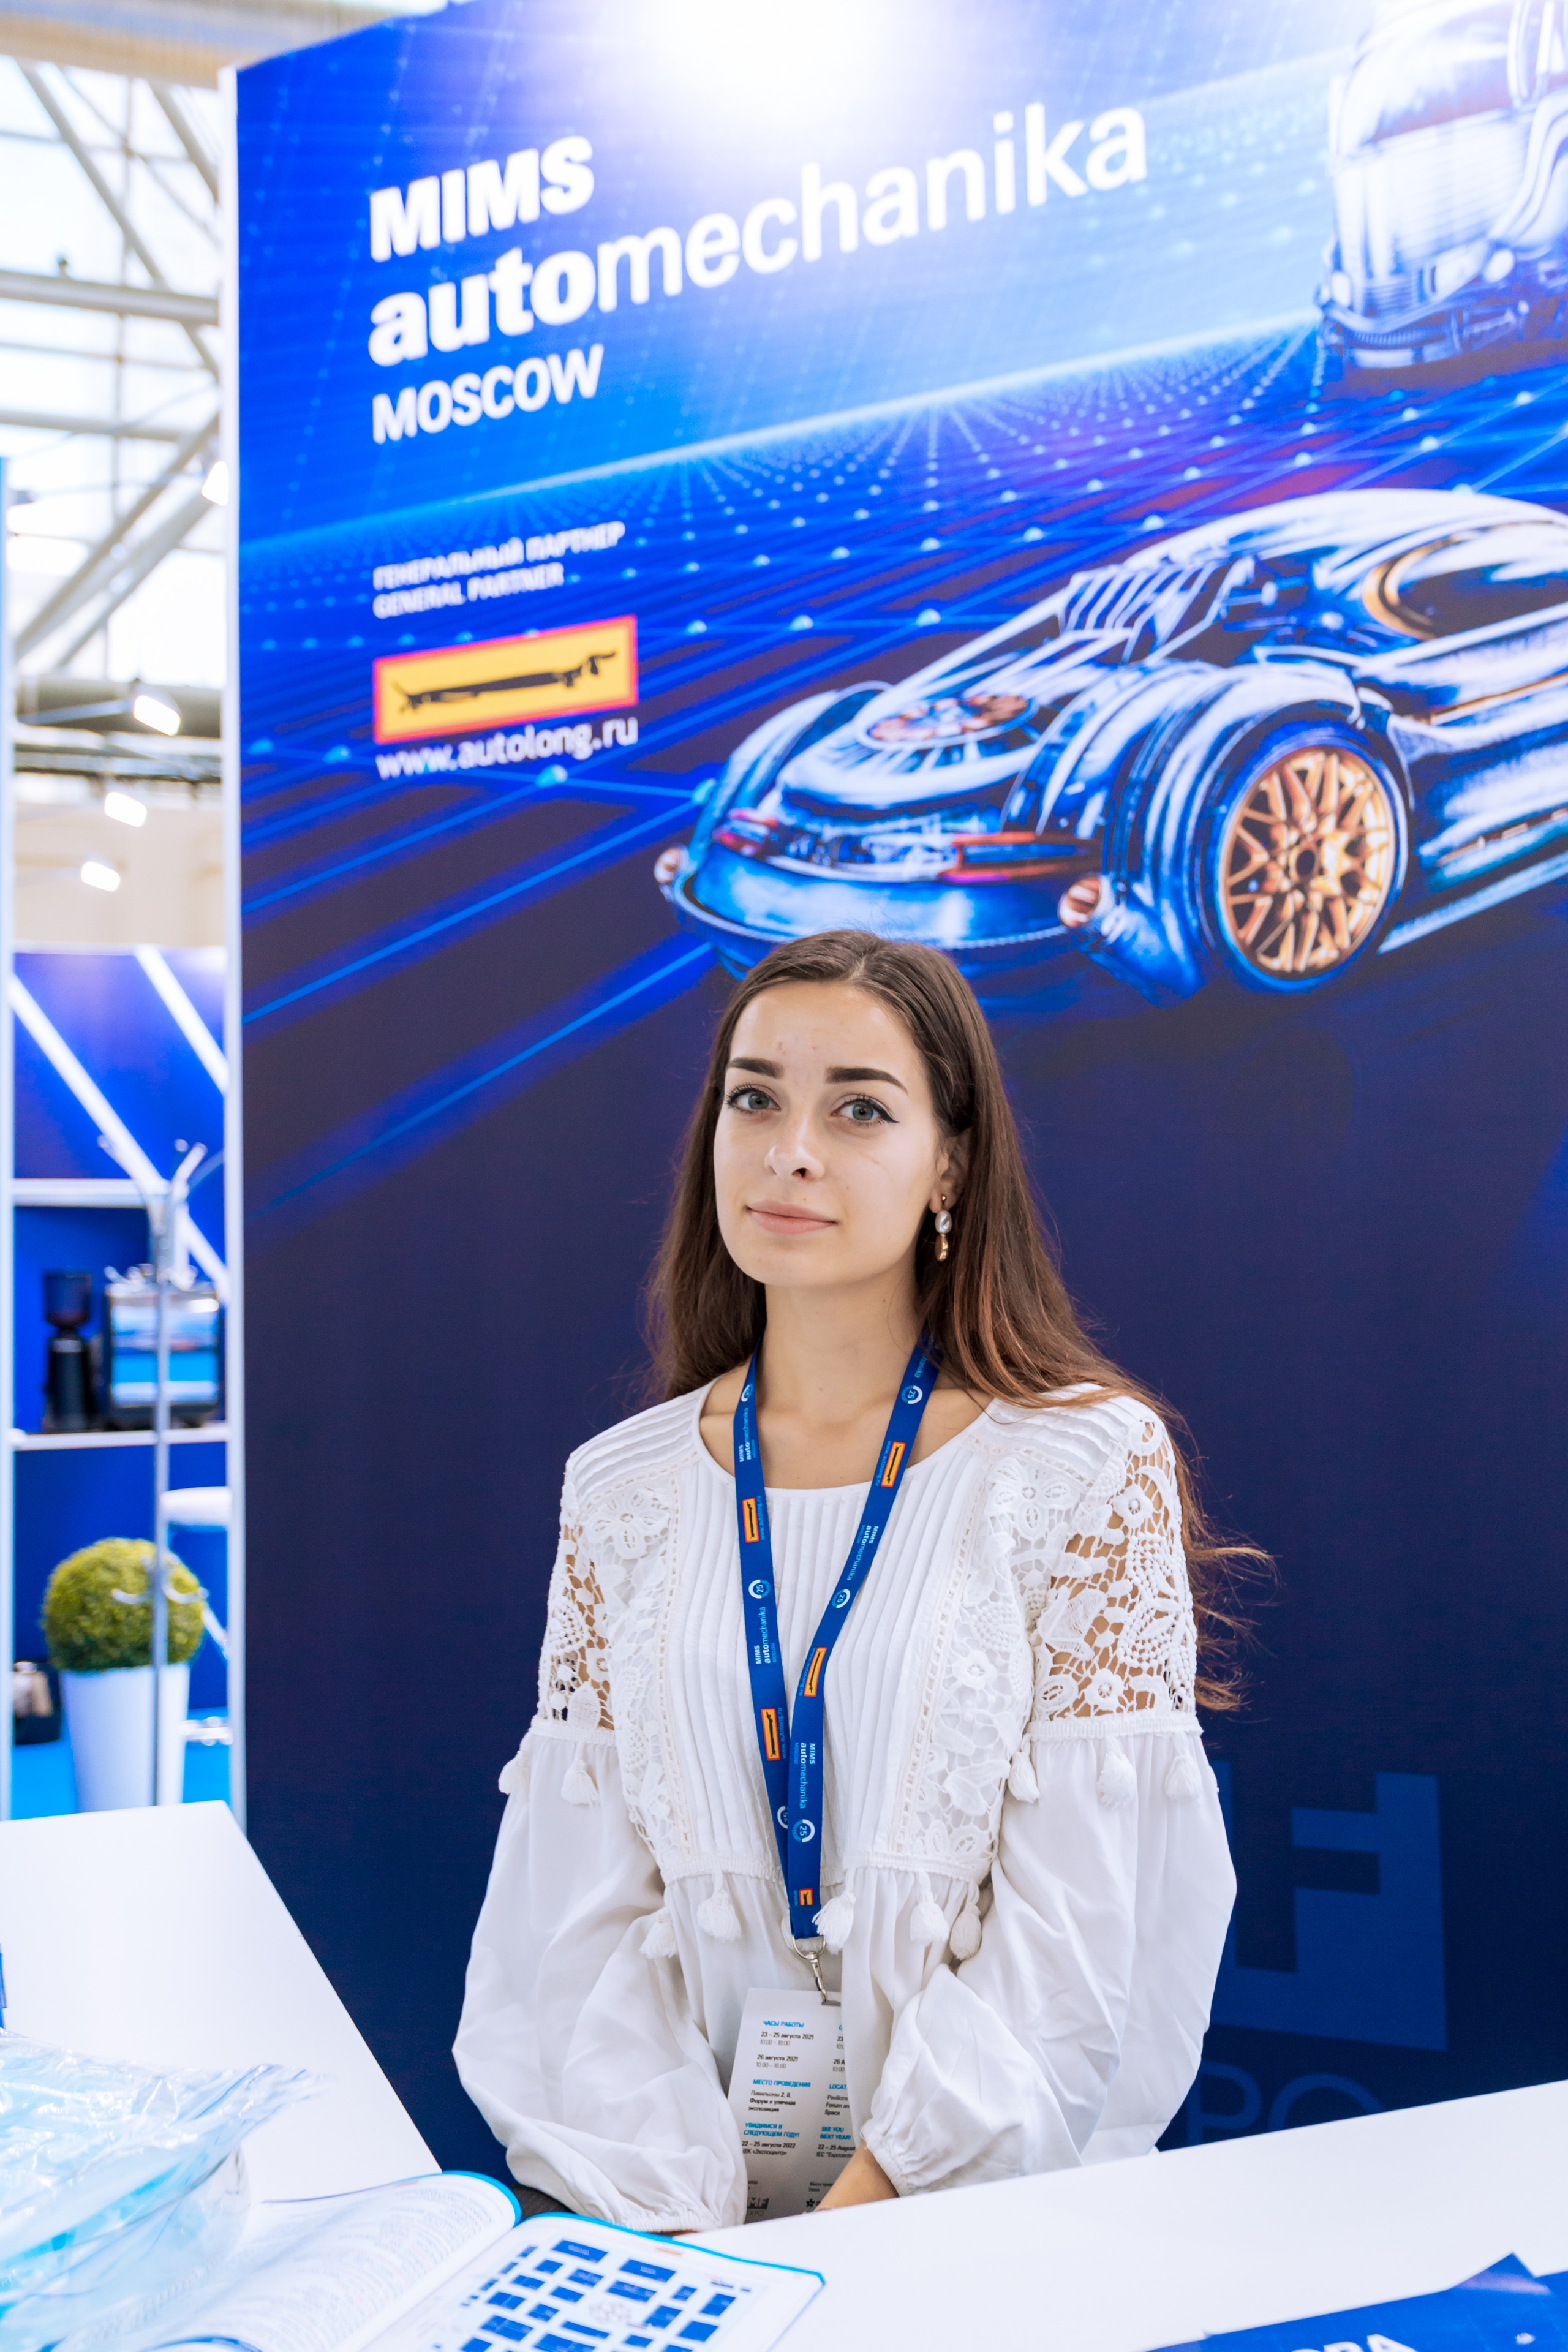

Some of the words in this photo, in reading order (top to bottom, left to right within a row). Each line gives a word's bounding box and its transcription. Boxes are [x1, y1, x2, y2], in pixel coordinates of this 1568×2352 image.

[369, 135, 594, 263] MIMS
[369, 101, 1147, 368] automechanika
[372, 344, 604, 445] MOSCOW
[373, 537, 524, 591] ГЕНЕРАЛЬНЫЙ
[526, 521, 625, 562] ПАРТНЕР
[373, 581, 466, 619] GENERAL
[467, 562, 564, 601] PARTNER
[375, 717, 638, 780] www.autolong.ru
[846, 1525, 872, 1581] automechanika
[868, 1525, 879, 1544] MIMS
[756, 1584, 764, 1593] 25
[758, 1607, 771, 1664] automechanika
[799, 1742, 808, 1809] automechanika
[799, 1825, 807, 1837] 25
